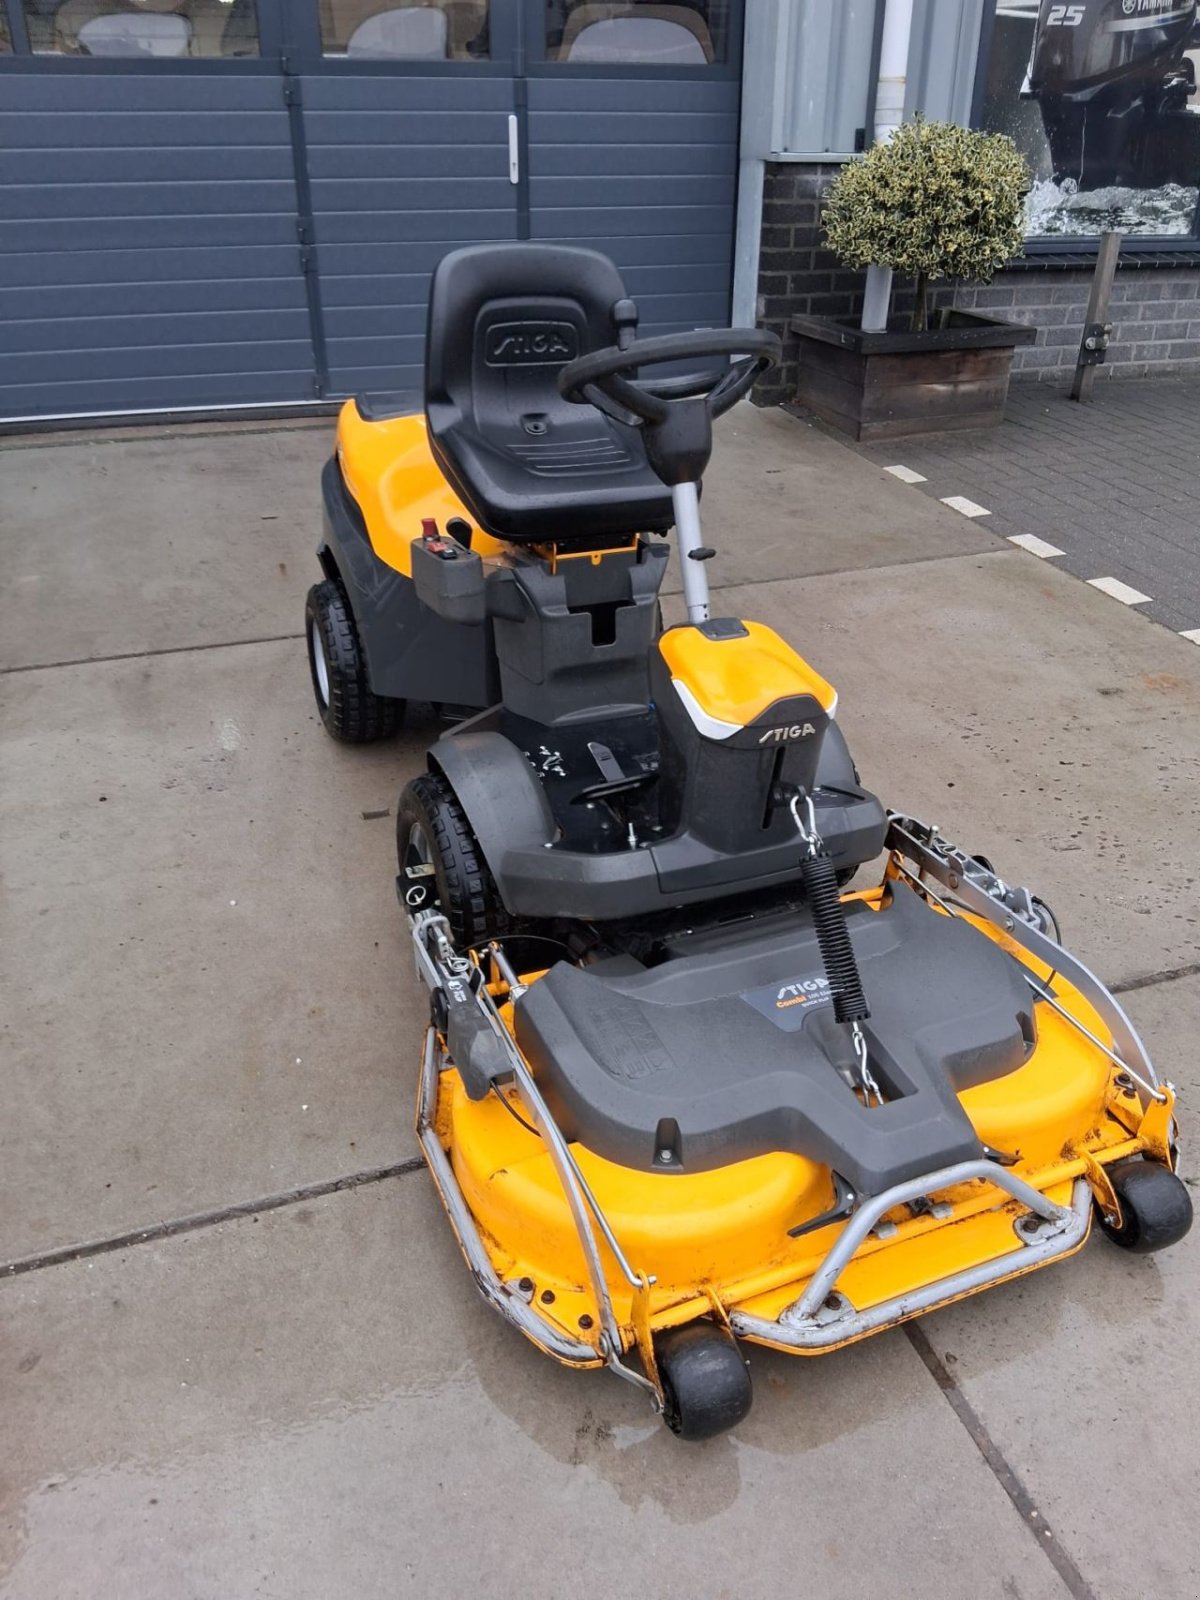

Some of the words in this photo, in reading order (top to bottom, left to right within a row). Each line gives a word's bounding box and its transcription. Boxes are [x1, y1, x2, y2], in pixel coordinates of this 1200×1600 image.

[1047, 5, 1086, 26] 25
[494, 334, 569, 355] STIGA
[759, 723, 816, 743] STIGA
[776, 995, 807, 1008] Combi
